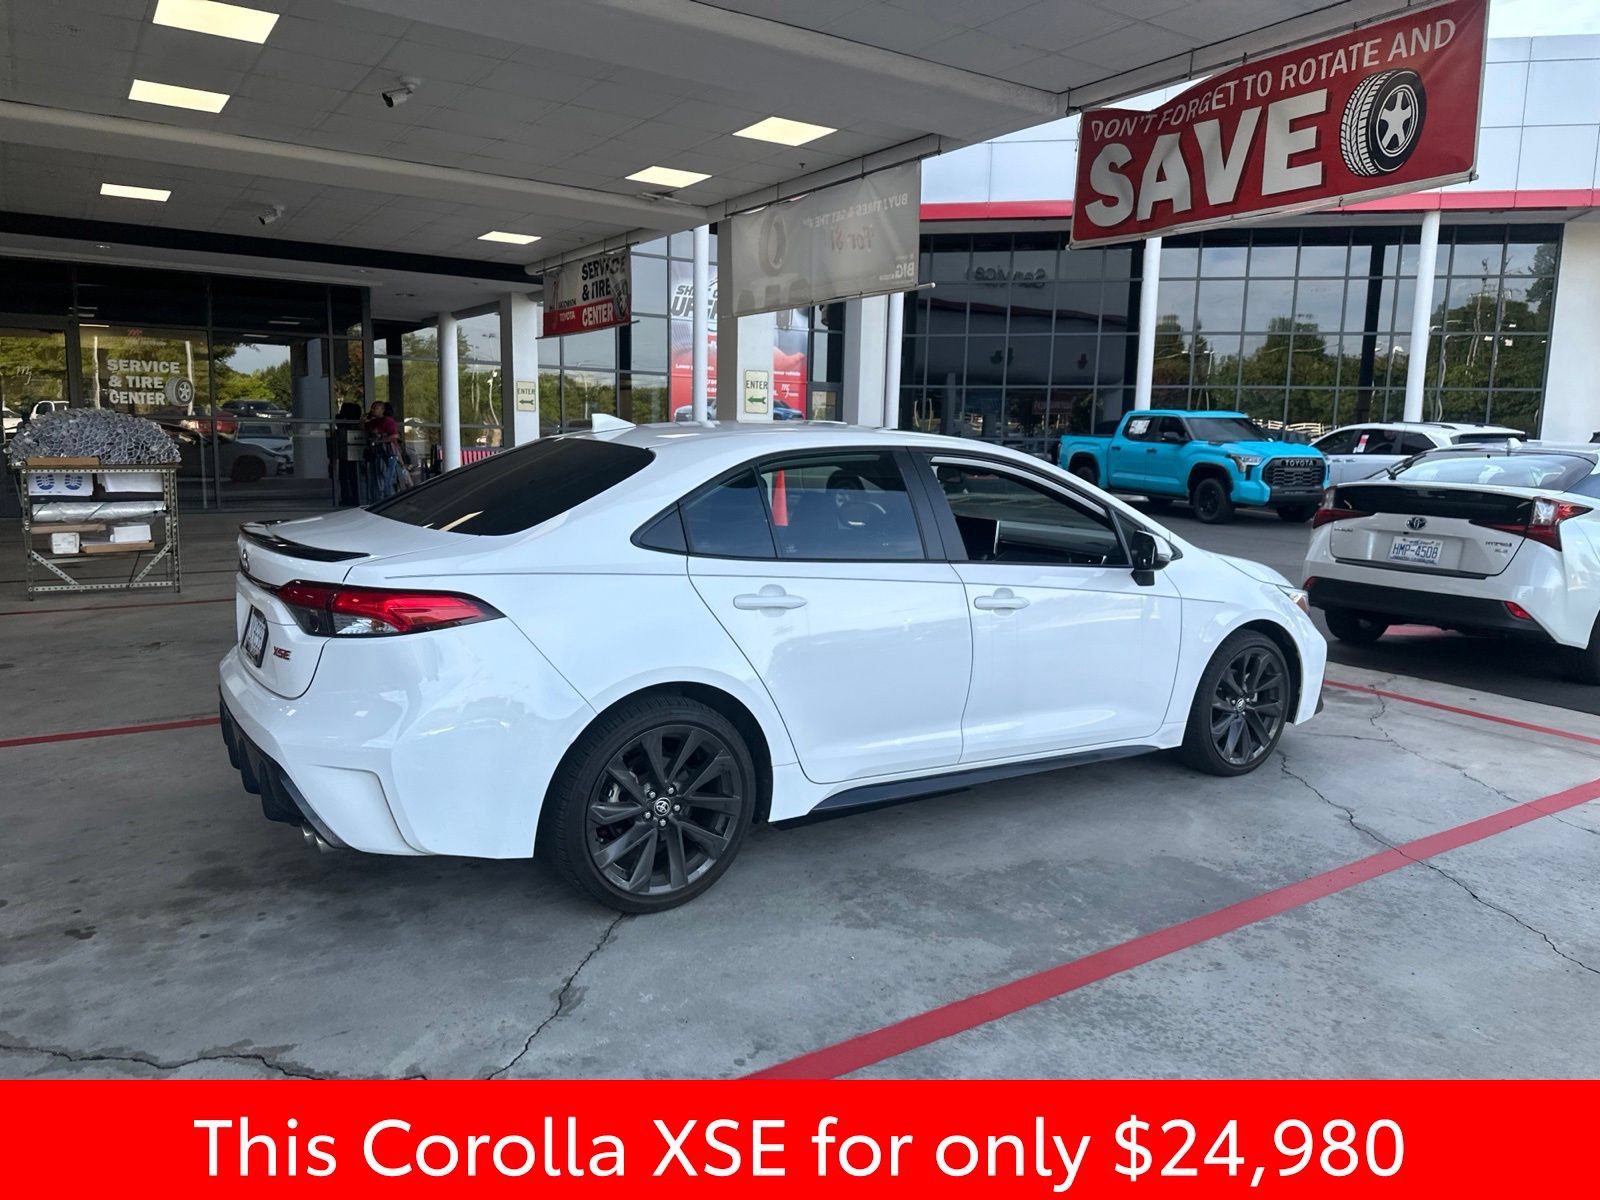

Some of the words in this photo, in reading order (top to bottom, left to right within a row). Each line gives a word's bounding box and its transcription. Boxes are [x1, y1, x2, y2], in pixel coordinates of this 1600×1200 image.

[1091, 112, 1158, 143] DON'T
[1158, 81, 1242, 130] FORGET
[1243, 70, 1272, 99] TO
[1280, 38, 1381, 90] ROTATE
[1387, 18, 1456, 61] AND
[1085, 88, 1328, 228] SAVE
[581, 255, 626, 281] SERVICE
[582, 283, 590, 302] &
[591, 277, 612, 299] TIRE
[582, 302, 614, 327] CENTER
[107, 359, 180, 374] SERVICE
[108, 375, 122, 388] &
[126, 376, 164, 389] TIRE
[745, 380, 769, 390] ENTER
[109, 391, 166, 405] CENTER
[1285, 460, 1314, 468] TOYOTA
[273, 645, 292, 661] XSE
